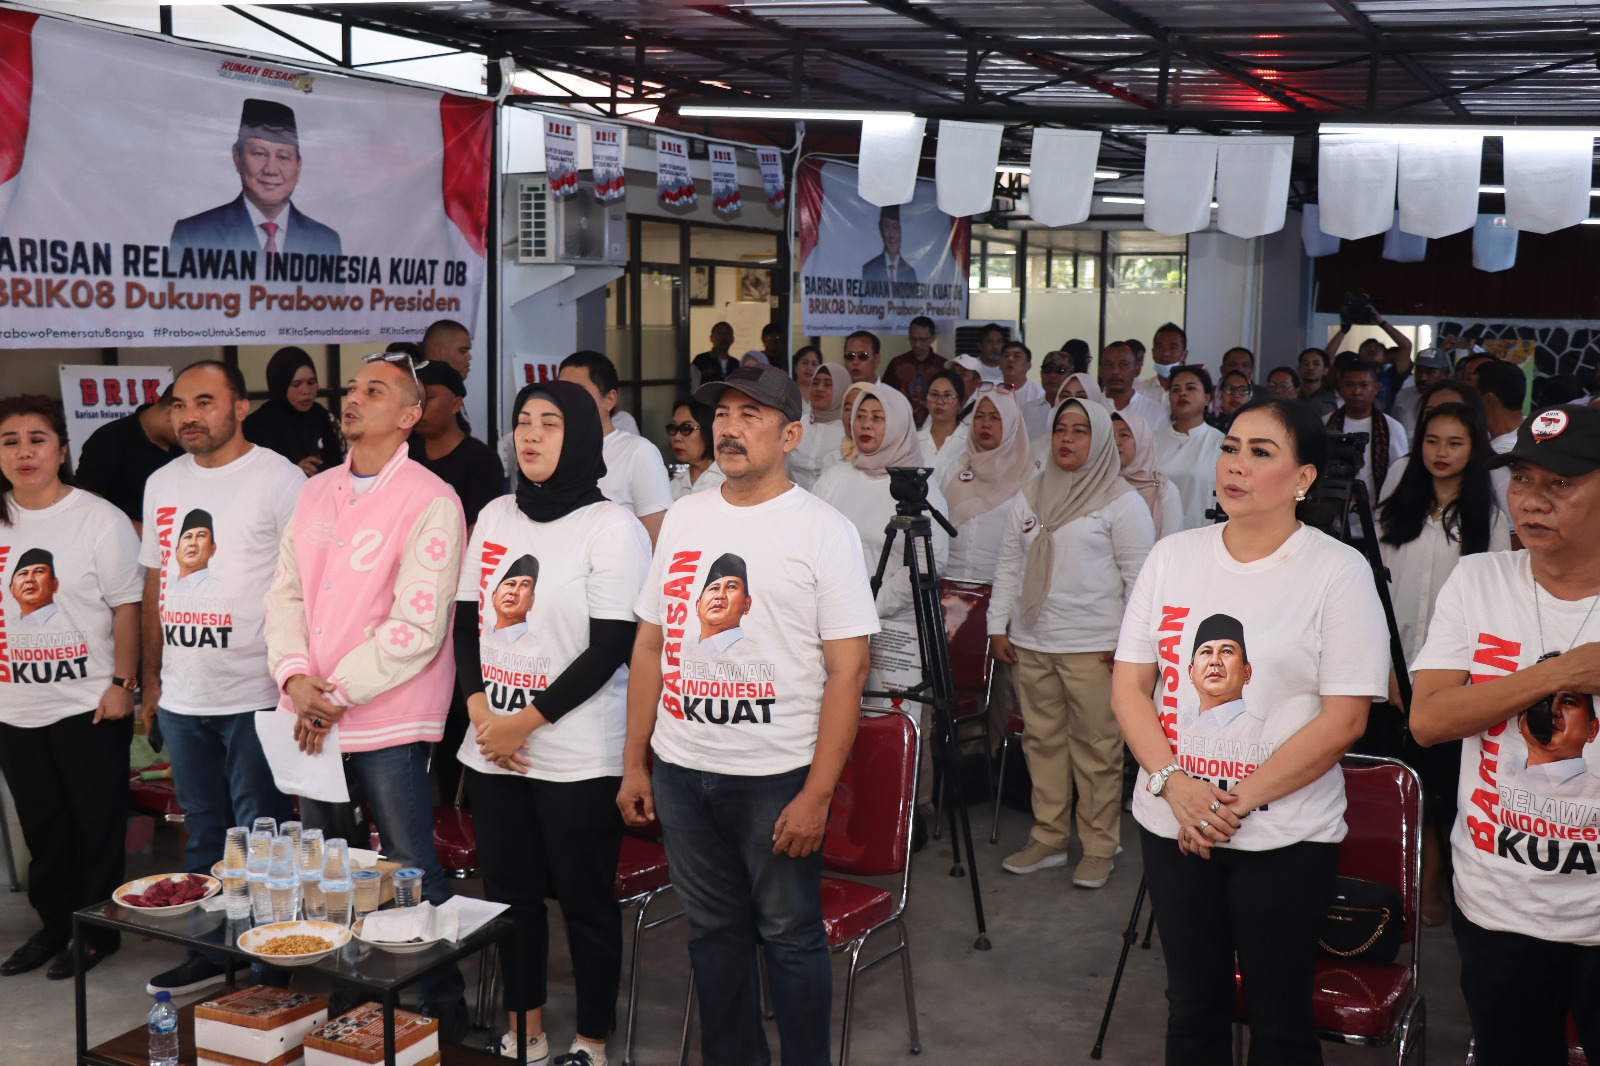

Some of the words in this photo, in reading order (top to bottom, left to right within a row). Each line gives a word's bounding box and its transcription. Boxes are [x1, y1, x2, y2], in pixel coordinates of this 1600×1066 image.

[220, 61, 261, 76] RUMAH
[261, 67, 297, 82] BESAR
[548, 122, 573, 136] BRIK
[0, 236, 112, 275] ARISAN
[123, 244, 257, 281] RELAWAN
[265, 251, 382, 284] INDONESIA
[389, 257, 440, 286] KUAT
[443, 260, 467, 287] 08
[125, 281, 240, 318] Dukung
[250, 284, 364, 312] Prabowo
[370, 288, 460, 312] Presiden
[805, 276, 844, 297] BARISAN
[846, 278, 890, 298] RELAWAN
[808, 298, 846, 315] BRIK08
[847, 301, 885, 319] Dukung
[887, 301, 924, 316] Prabowo
[0, 327, 145, 340] rabowoPemersatuBangsa
[153, 327, 266, 338] #PrabowoUntukSemua
[278, 327, 370, 337] #KitaSemuaIndonesia
[524, 363, 559, 384] BRI
[79, 378, 161, 406] BRIK
[75, 410, 99, 419] Barisan
[164, 611, 233, 626] INDONESIA
[8, 631, 88, 649] RELAWAN
[165, 624, 233, 648] KUAT
[663, 551, 702, 720] BARISAN
[10, 643, 89, 661] INDONESIA
[480, 646, 551, 675] RELAWAN
[12, 656, 89, 684] KUAT
[480, 663, 548, 689] NDONESIA
[683, 660, 775, 682] RELAWAN
[1156, 605, 1191, 756] RISAN
[682, 679, 776, 698] INDONESIA
[683, 695, 776, 724] KUAT
[1179, 734, 1275, 763] RELAWAN
[1179, 754, 1260, 780] INDONES
[1498, 785, 1600, 828] RELAWA
[1500, 813, 1600, 842] INDONES
[1497, 826, 1600, 875] KUA
